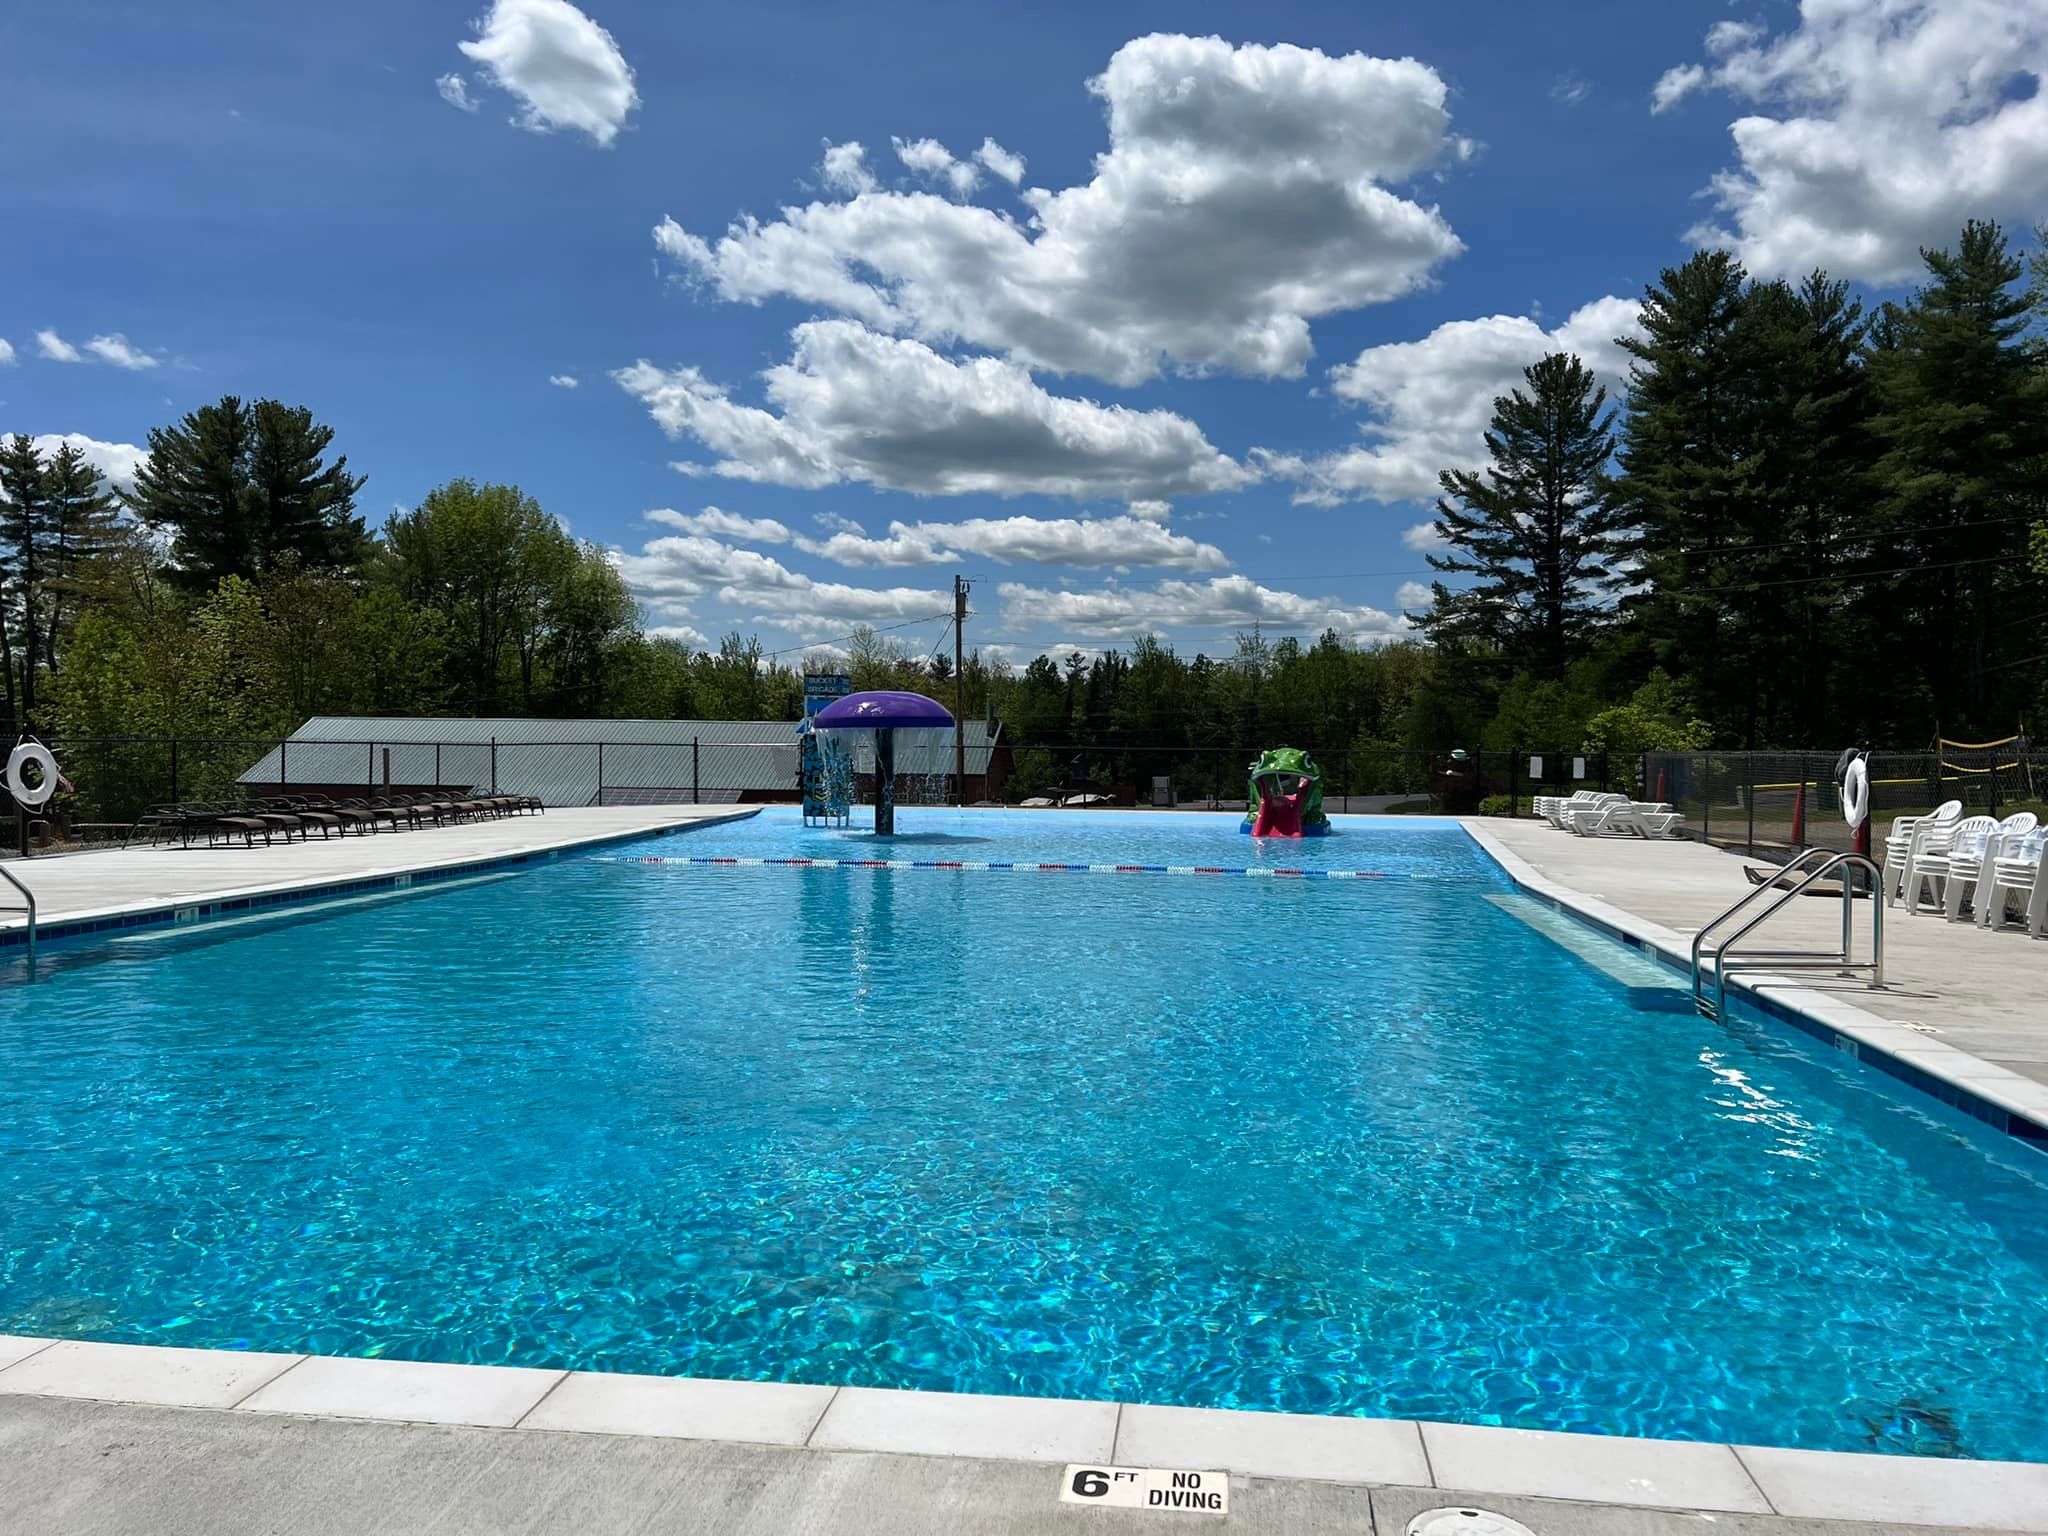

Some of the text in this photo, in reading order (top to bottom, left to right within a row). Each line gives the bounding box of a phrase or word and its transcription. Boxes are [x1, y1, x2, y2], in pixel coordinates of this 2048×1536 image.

[1072, 1470, 1139, 1497] 6 FT
[1172, 1472, 1201, 1489] NO
[1148, 1490, 1222, 1510] DIVING
